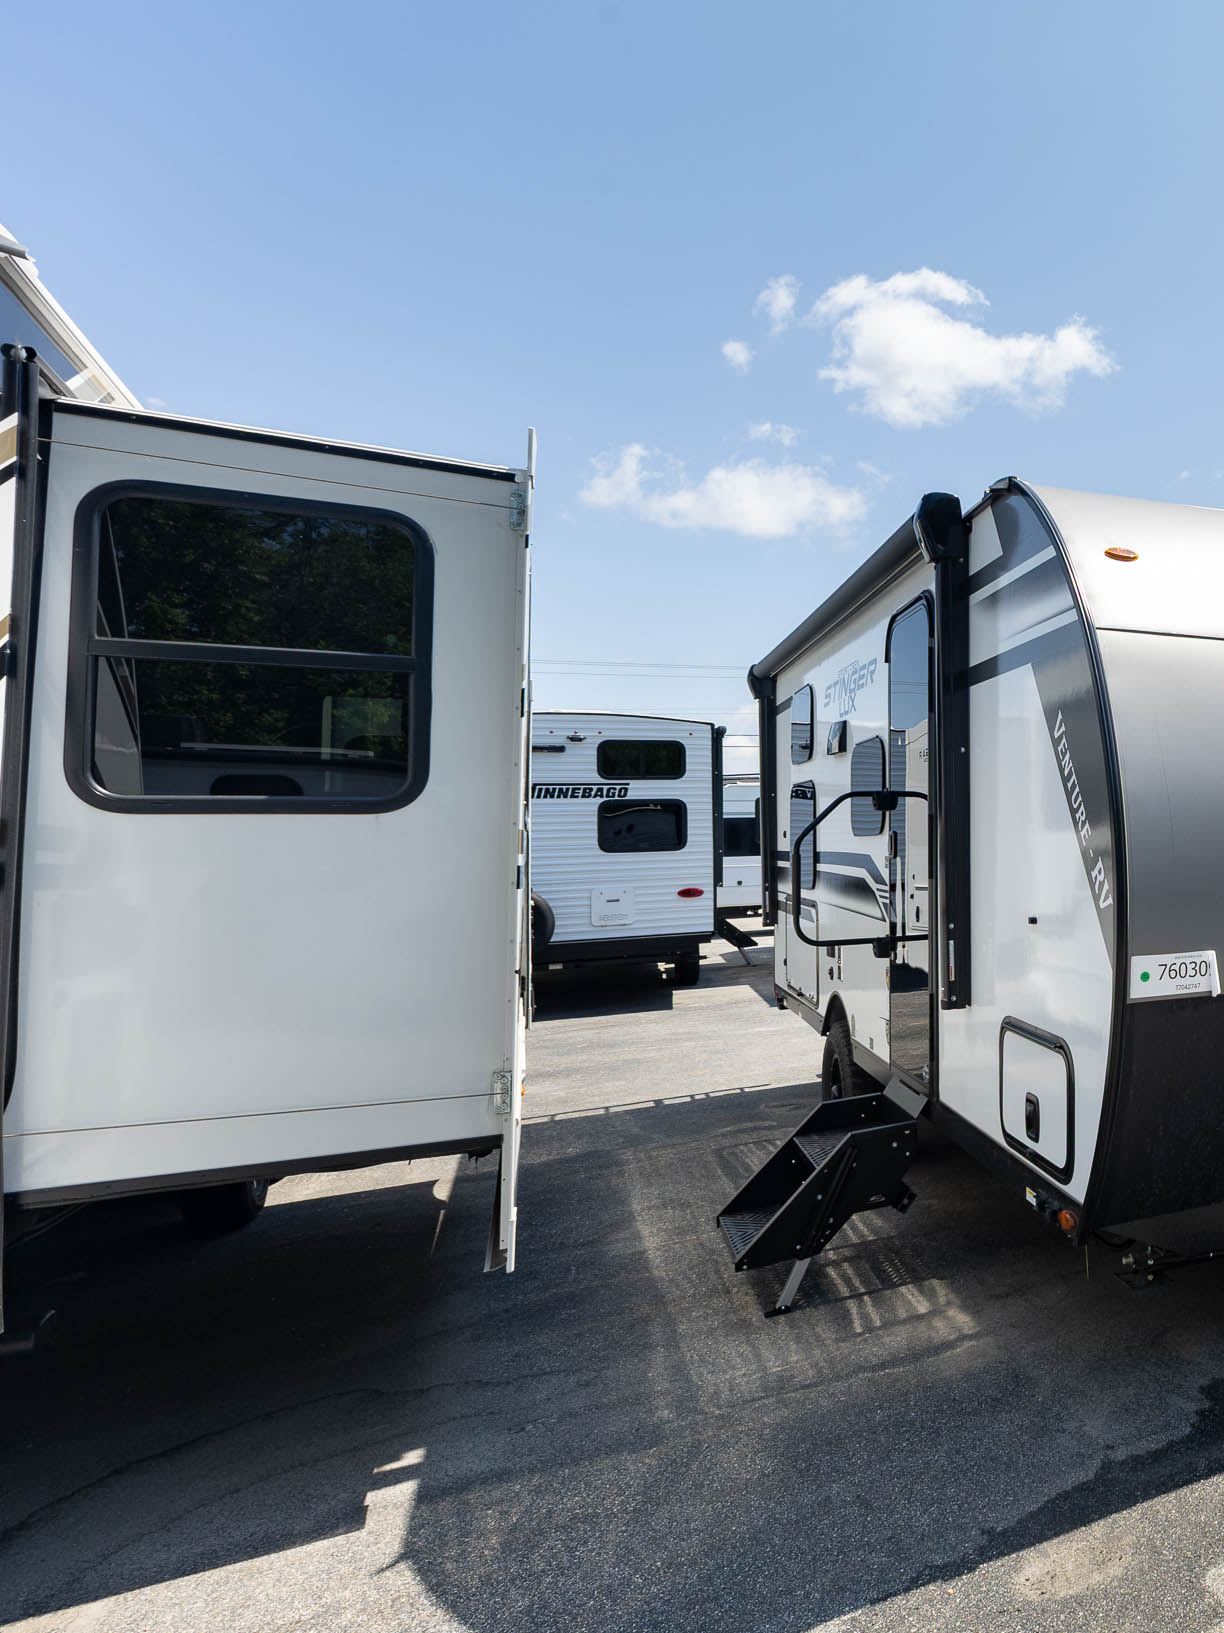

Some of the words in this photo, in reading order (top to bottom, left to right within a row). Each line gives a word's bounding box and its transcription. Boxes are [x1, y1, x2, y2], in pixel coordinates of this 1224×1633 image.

[823, 658, 878, 708] STINGER
[839, 692, 857, 719] LUX
[531, 783, 630, 799] INNEBAGO
[1053, 709, 1092, 846] VENTURE
[1091, 856, 1114, 909] RV
[1157, 960, 1211, 981] 76030
